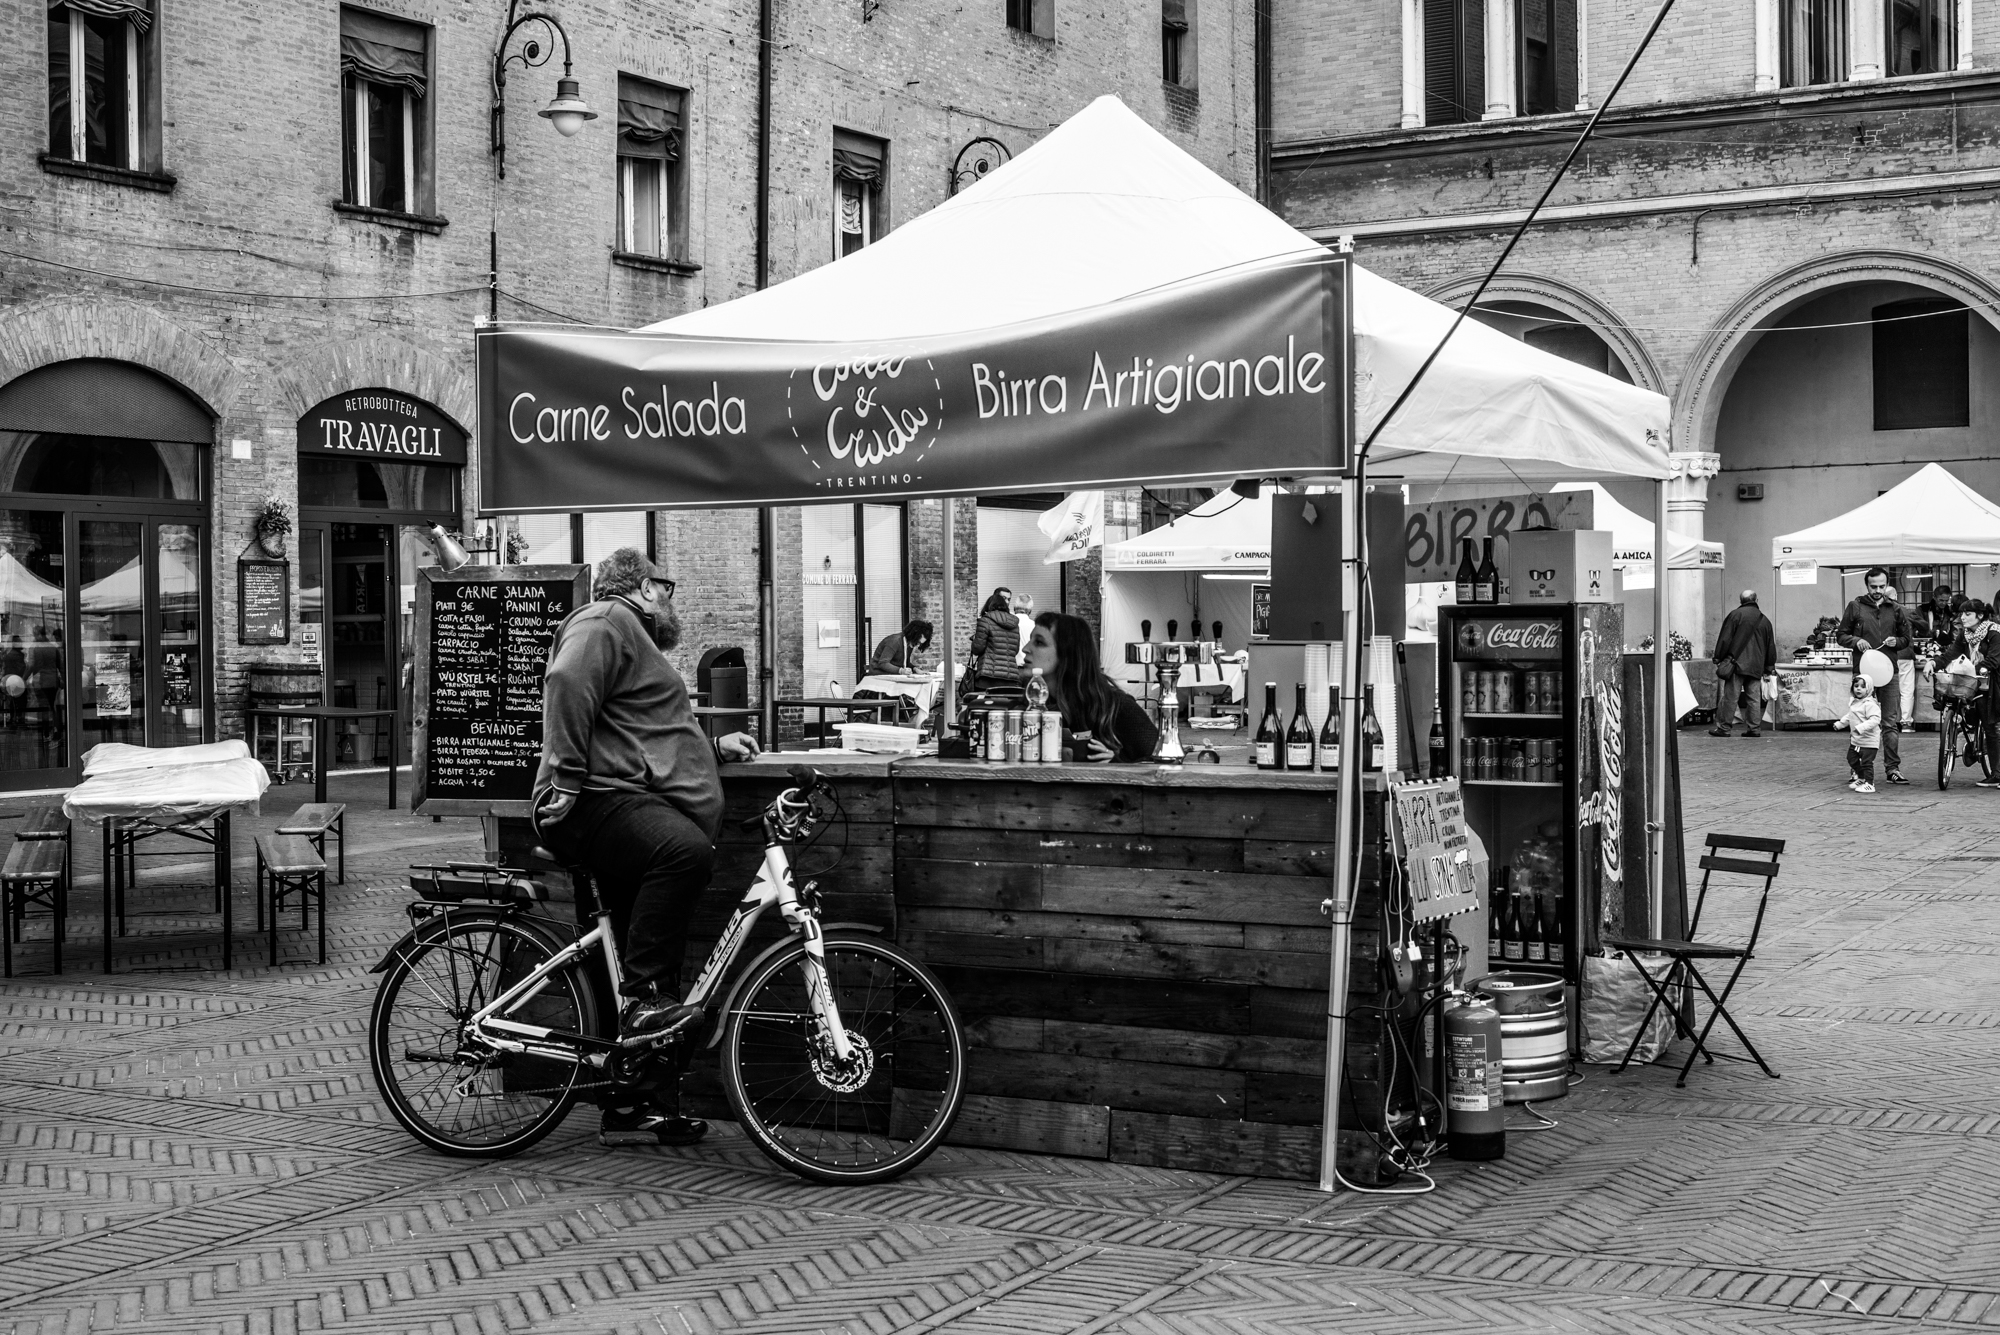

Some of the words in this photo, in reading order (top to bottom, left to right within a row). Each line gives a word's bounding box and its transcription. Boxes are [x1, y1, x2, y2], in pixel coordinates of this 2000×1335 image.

[971, 362, 1067, 419] Birra
[1082, 334, 1326, 414] Artigianale
[345, 396, 418, 419] RETROBOTTEGA
[854, 385, 877, 417] &
[508, 391, 611, 444] Carne
[621, 380, 747, 439] Salada
[320, 418, 442, 457] TRAVAGLI
[826, 403, 929, 468] Cruda
[826, 473, 912, 488] TRENTINO
[1621, 551, 1652, 560] AMICA
[832, 574, 858, 584] FERRARA
[456, 586, 498, 599] CARNE
[503, 586, 546, 599] SALADA
[460, 601, 475, 612] 9€
[505, 600, 541, 613] PANINI
[547, 601, 564, 613] 6€
[1486, 622, 1561, 649] Coca-Cola
[437, 638, 479, 649] CARPACCIO
[438, 670, 484, 684] WÜRSTEL
[484, 673, 498, 684] 7€
[470, 722, 527, 736] BEVANDE
[436, 736, 460, 746] BIRRA
[436, 747, 460, 755] BIRRA
[437, 757, 454, 765] VINO
[515, 758, 528, 767] 2€
[1601, 679, 1622, 882] Coca-Cola
[1400, 791, 1441, 851] BIRRA
